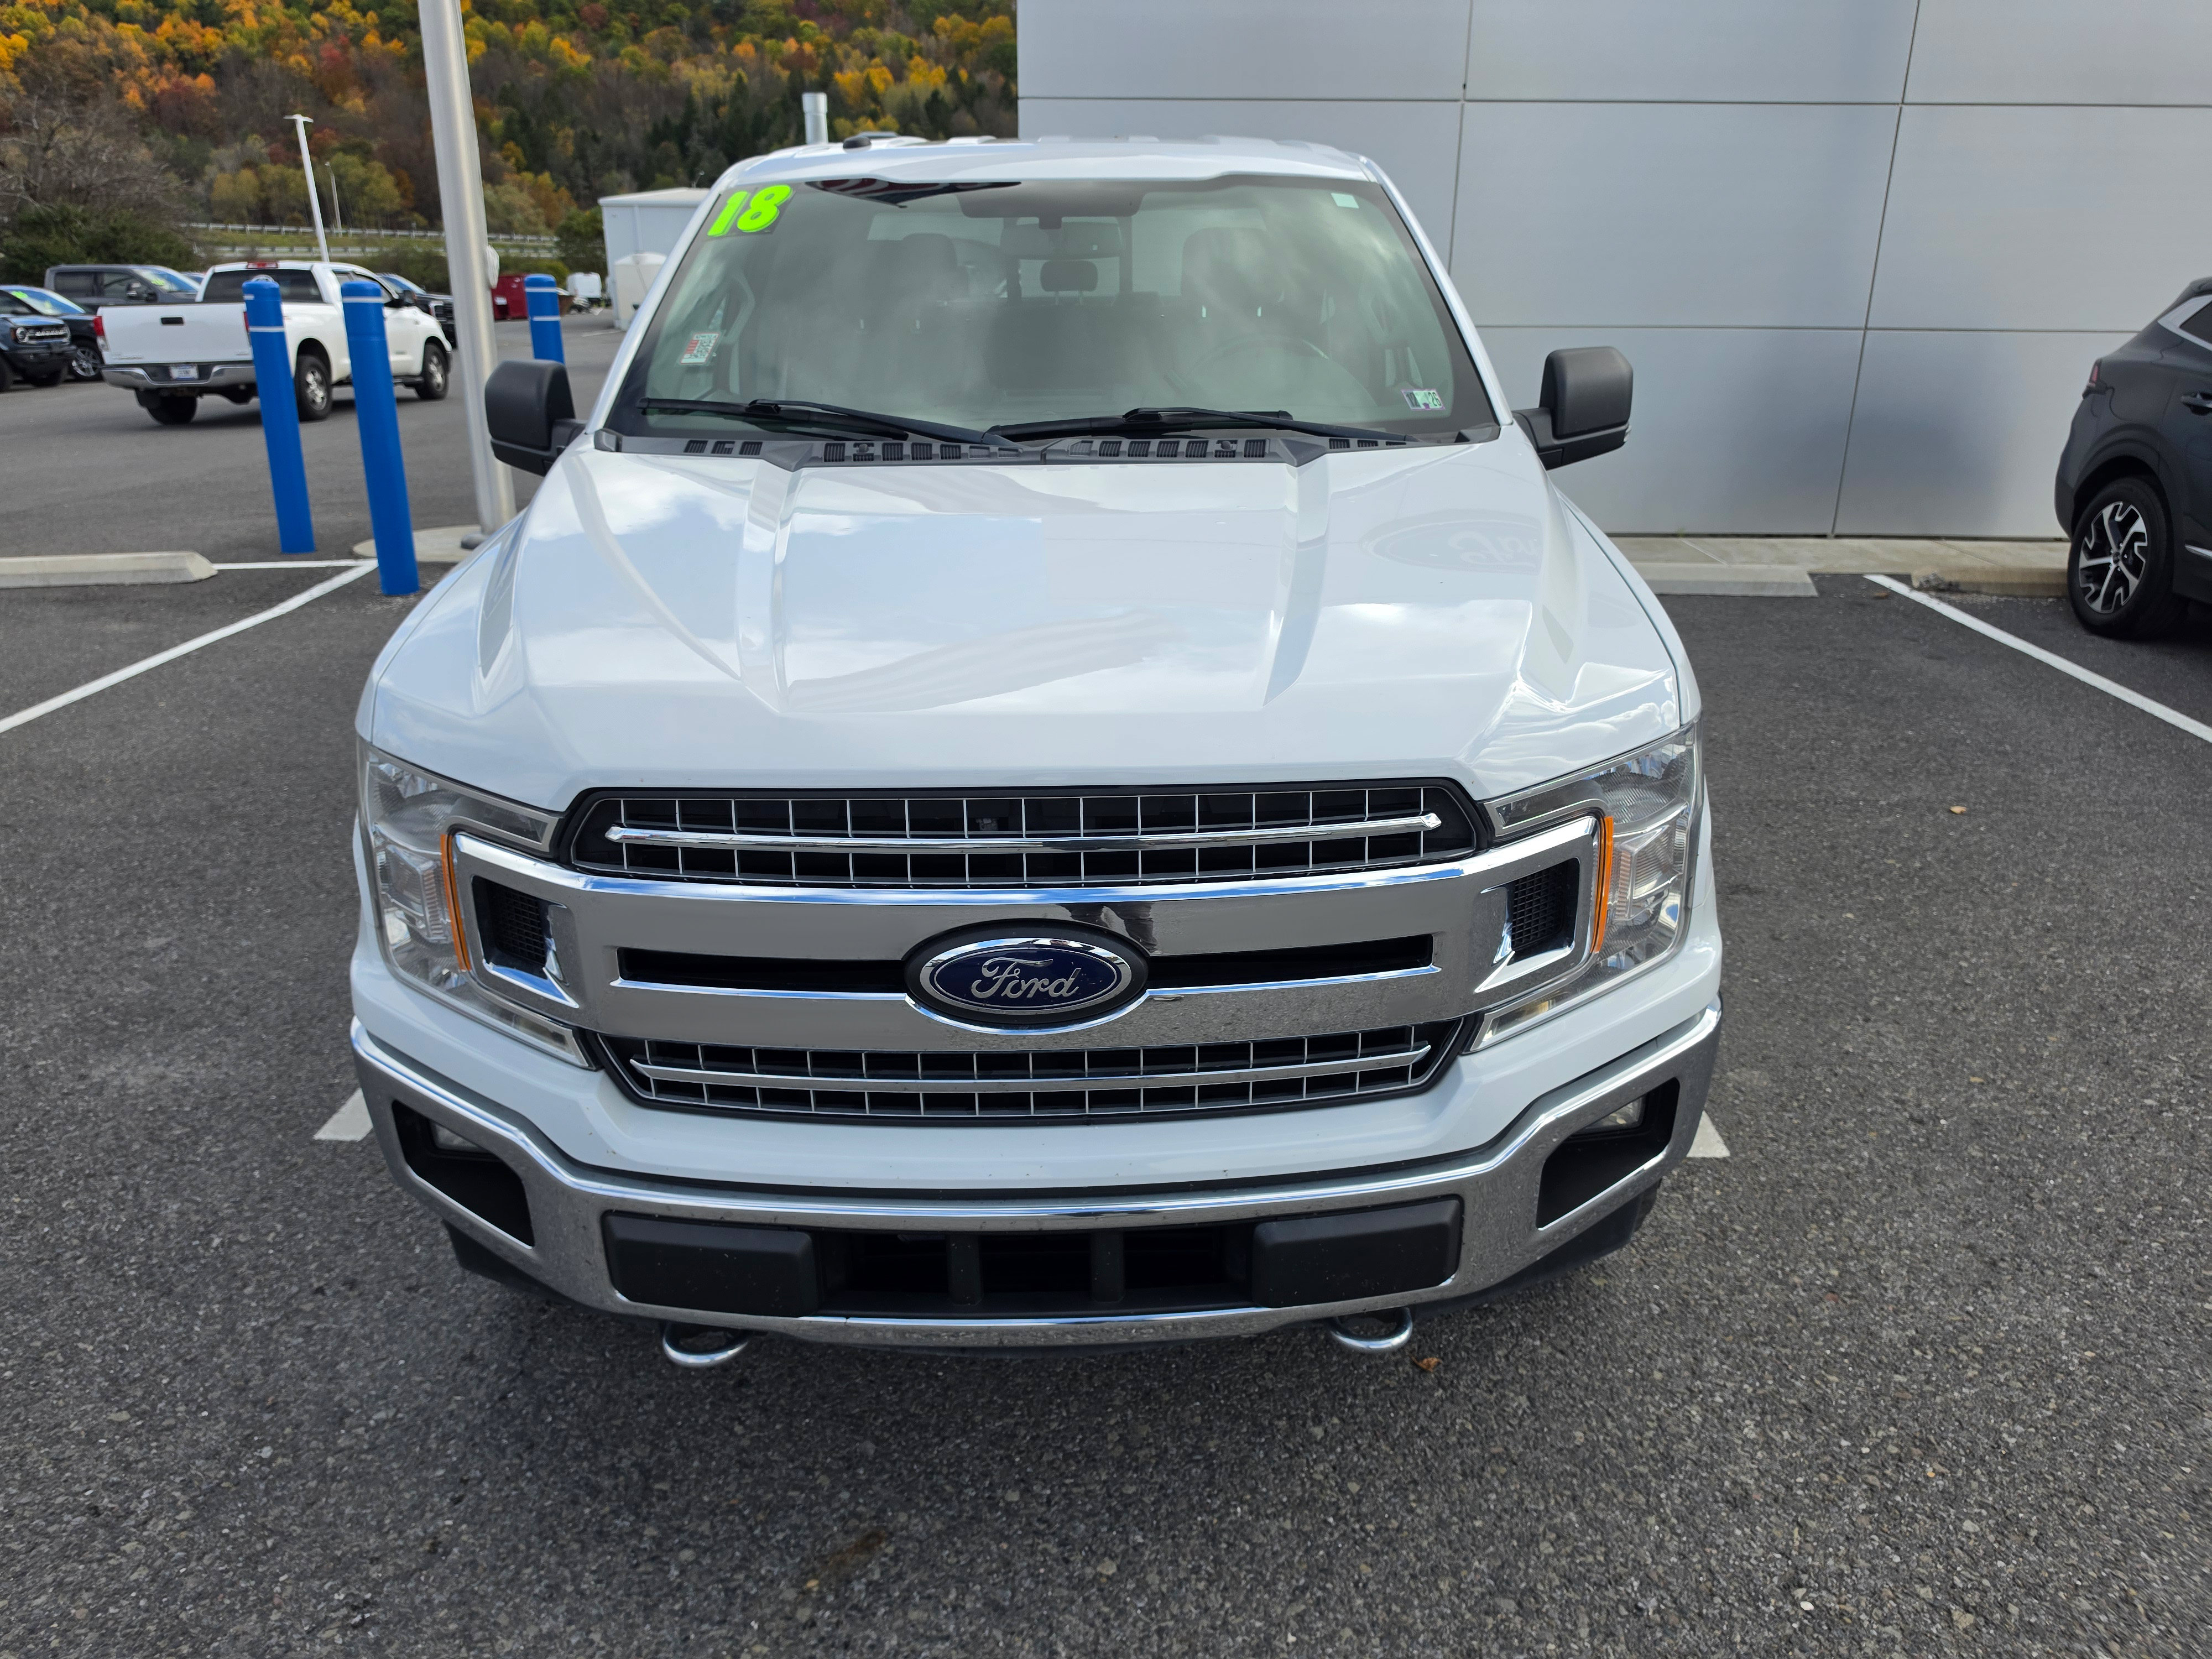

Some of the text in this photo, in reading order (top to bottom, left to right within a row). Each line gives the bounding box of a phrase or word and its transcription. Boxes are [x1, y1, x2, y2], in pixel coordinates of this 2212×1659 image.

[707, 184, 793, 237] 18
[1428, 392, 1442, 406] 26
[971, 957, 1082, 998] Ford
